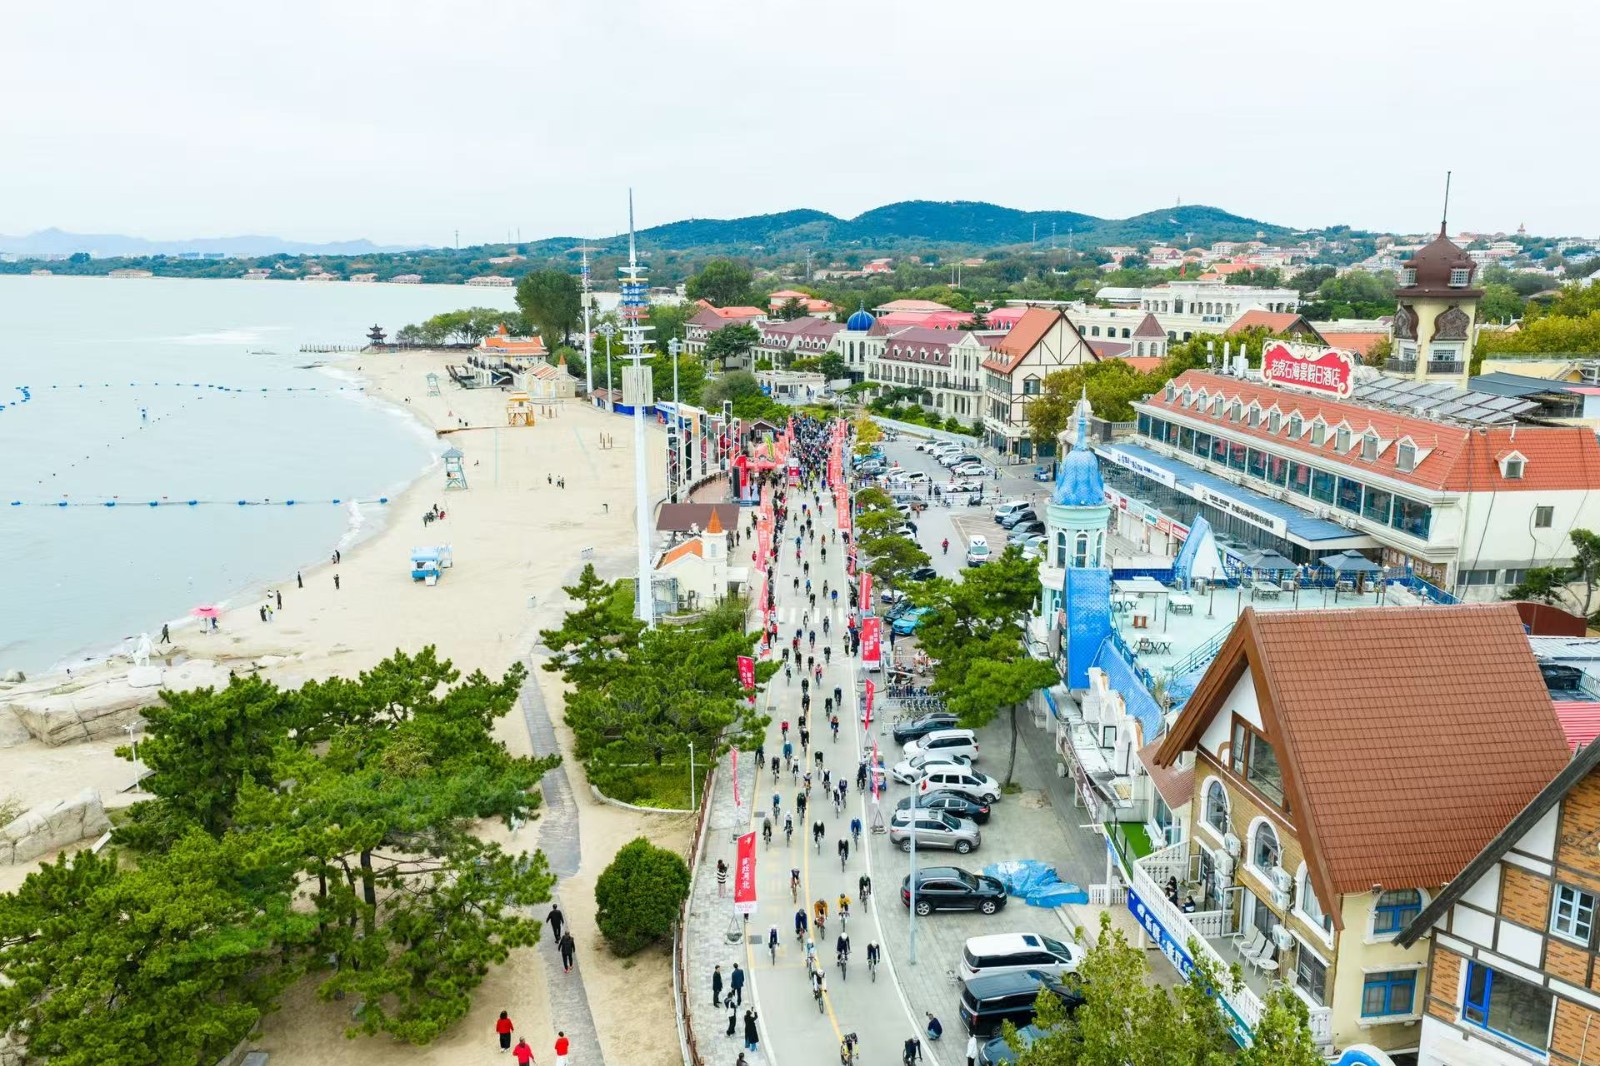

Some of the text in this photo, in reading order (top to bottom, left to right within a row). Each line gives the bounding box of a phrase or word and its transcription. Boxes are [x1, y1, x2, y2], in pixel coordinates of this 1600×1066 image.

[1272, 359, 1341, 388] 老虎石海景假日酒店
